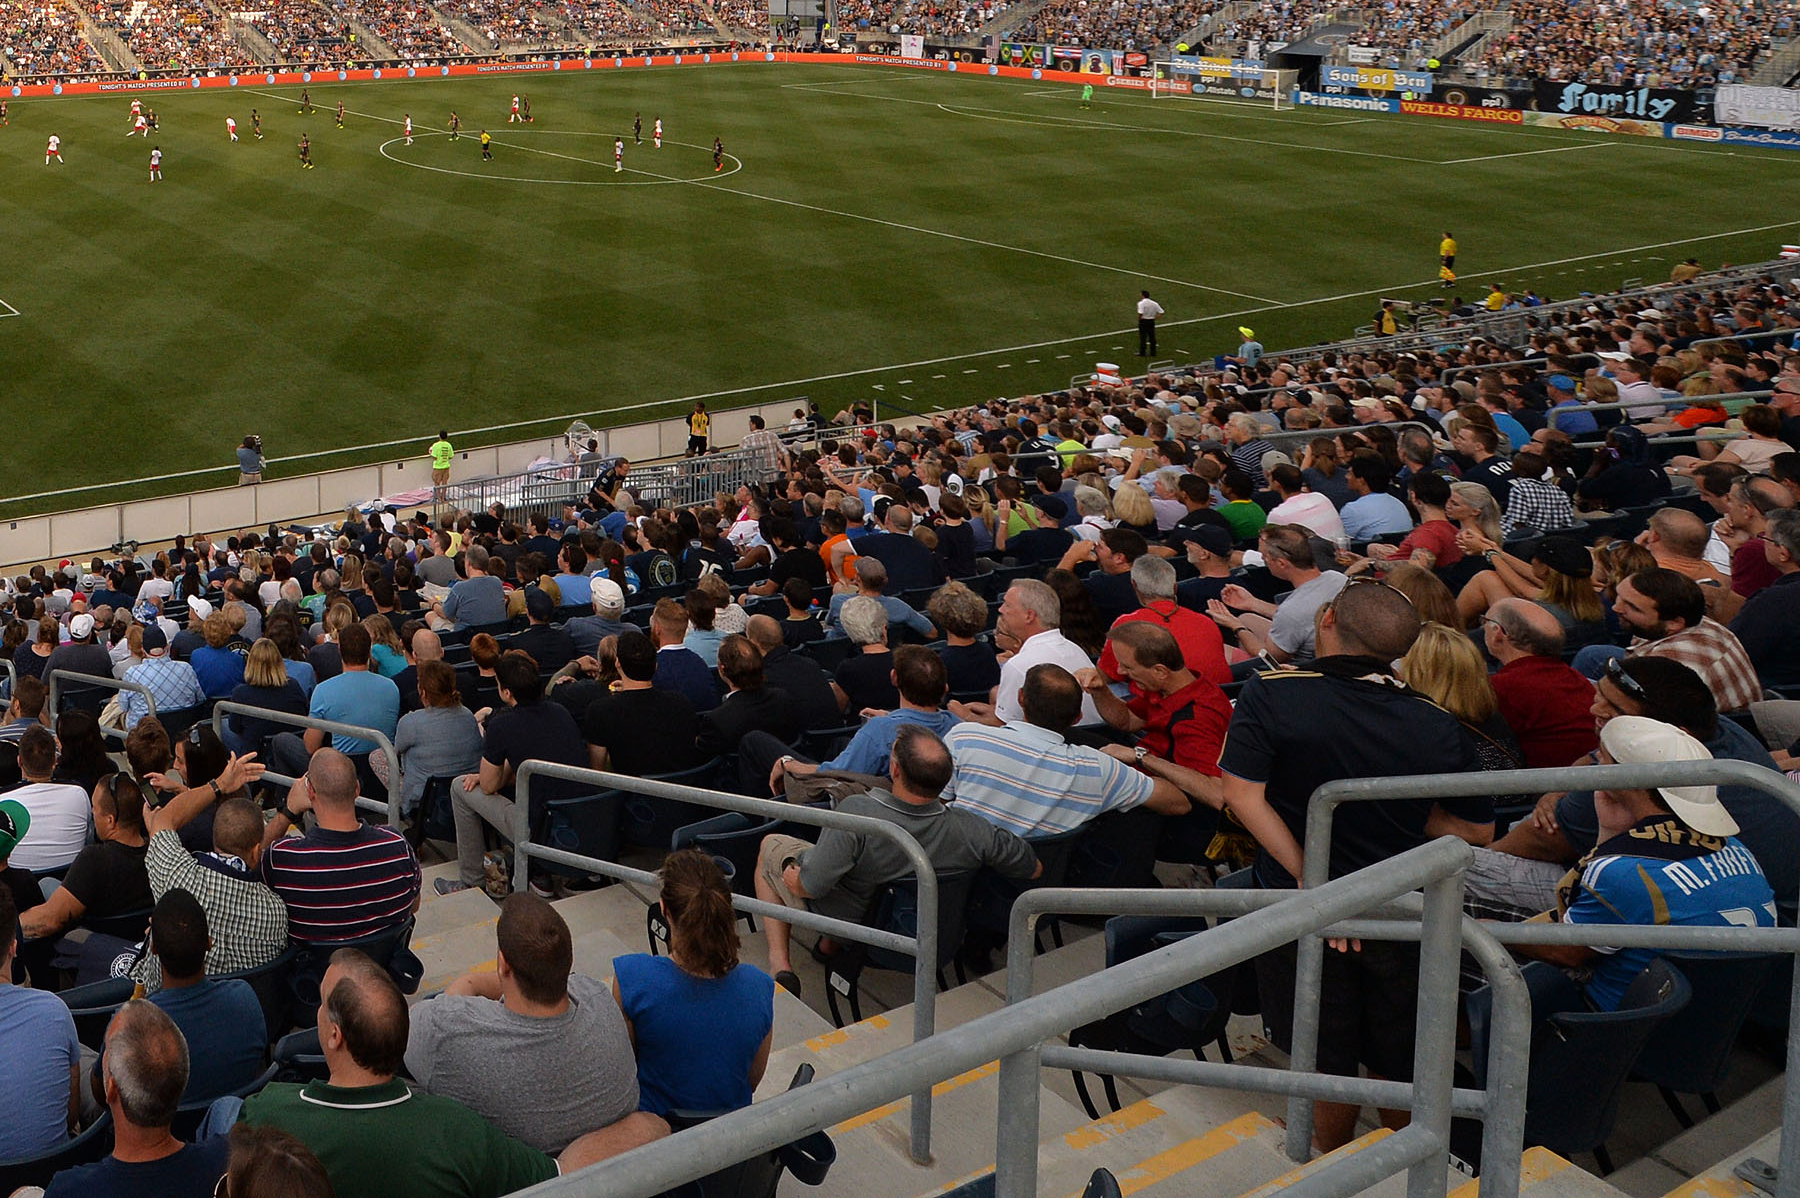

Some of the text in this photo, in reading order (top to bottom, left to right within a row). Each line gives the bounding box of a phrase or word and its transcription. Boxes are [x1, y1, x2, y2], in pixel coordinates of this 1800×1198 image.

[856, 55, 885, 63] TONIGHT'S
[903, 58, 934, 67] PRESENTED
[1329, 69, 1426, 88] Sons of Ben
[1206, 86, 1237, 96] Allstate
[1300, 92, 1390, 112] Panasonic
[1481, 97, 1500, 108] ppl
[1557, 82, 1677, 119] Family
[1401, 102, 1523, 122] WELLS FARGO
[1676, 127, 1719, 138] BIMBO
